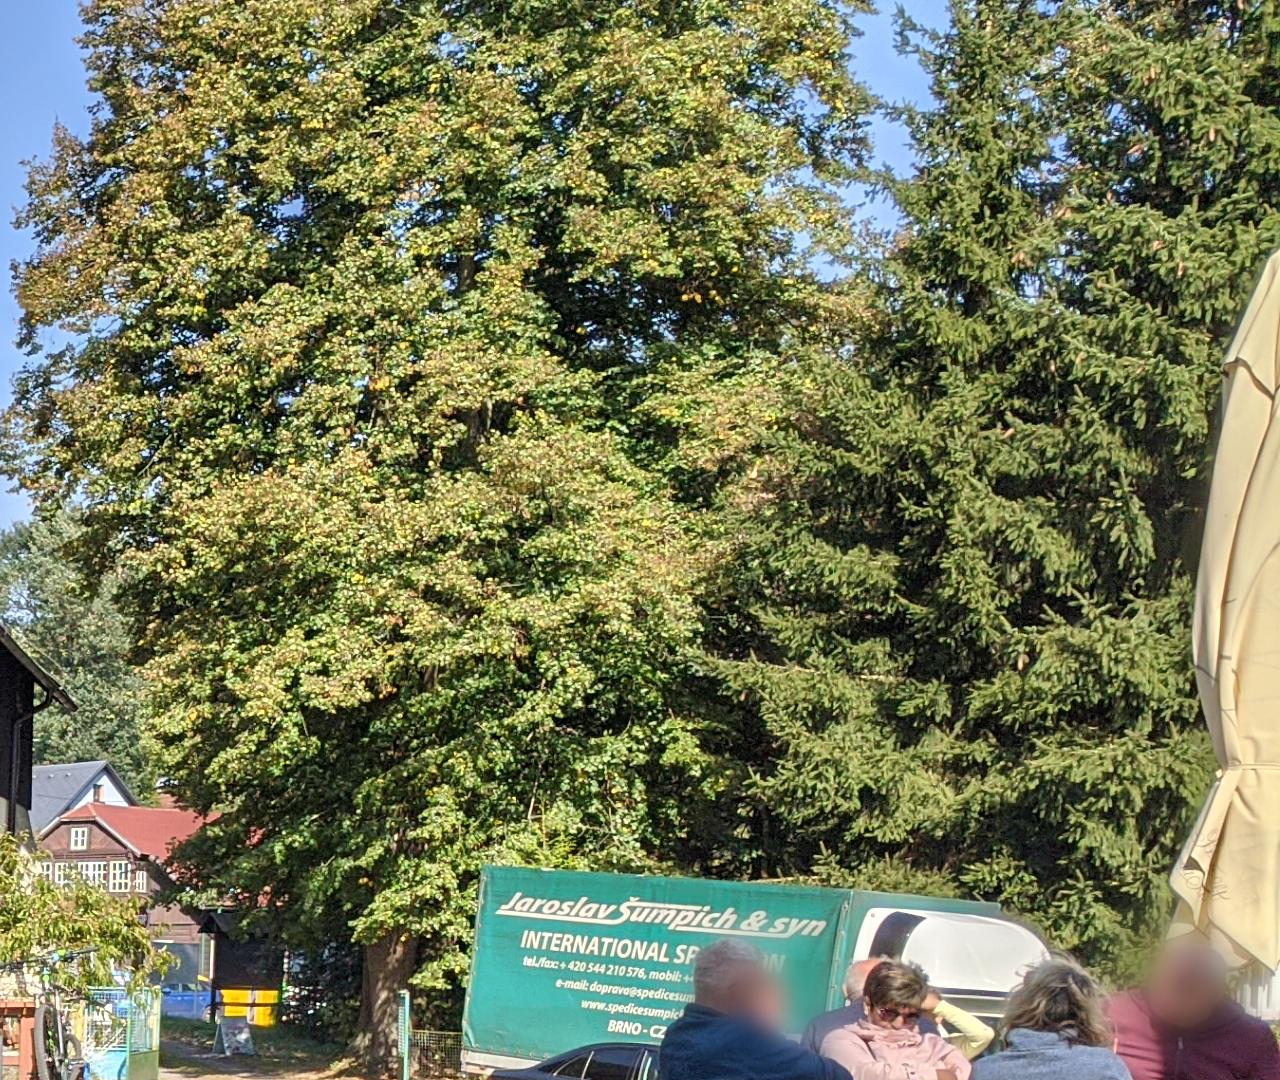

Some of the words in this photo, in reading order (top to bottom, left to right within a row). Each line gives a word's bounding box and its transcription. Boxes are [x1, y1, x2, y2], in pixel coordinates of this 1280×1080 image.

[500, 891, 618, 919] Jaroslav
[618, 896, 738, 931] Šumpich
[740, 910, 768, 932] &
[768, 917, 828, 938] syn
[520, 930, 670, 962] INTERNATIONAL
[522, 956, 559, 969] tel./fax:
[568, 962, 586, 972] 420
[587, 963, 606, 974] 544
[606, 965, 625, 976] 210
[627, 966, 647, 979] 576,
[648, 969, 682, 983] mobil:
[555, 979, 589, 991] e-mail:
[589, 982, 696, 1003] doprava@spedicesum
[607, 1020, 641, 1036] BRNO
[649, 1025, 668, 1039] CZ
